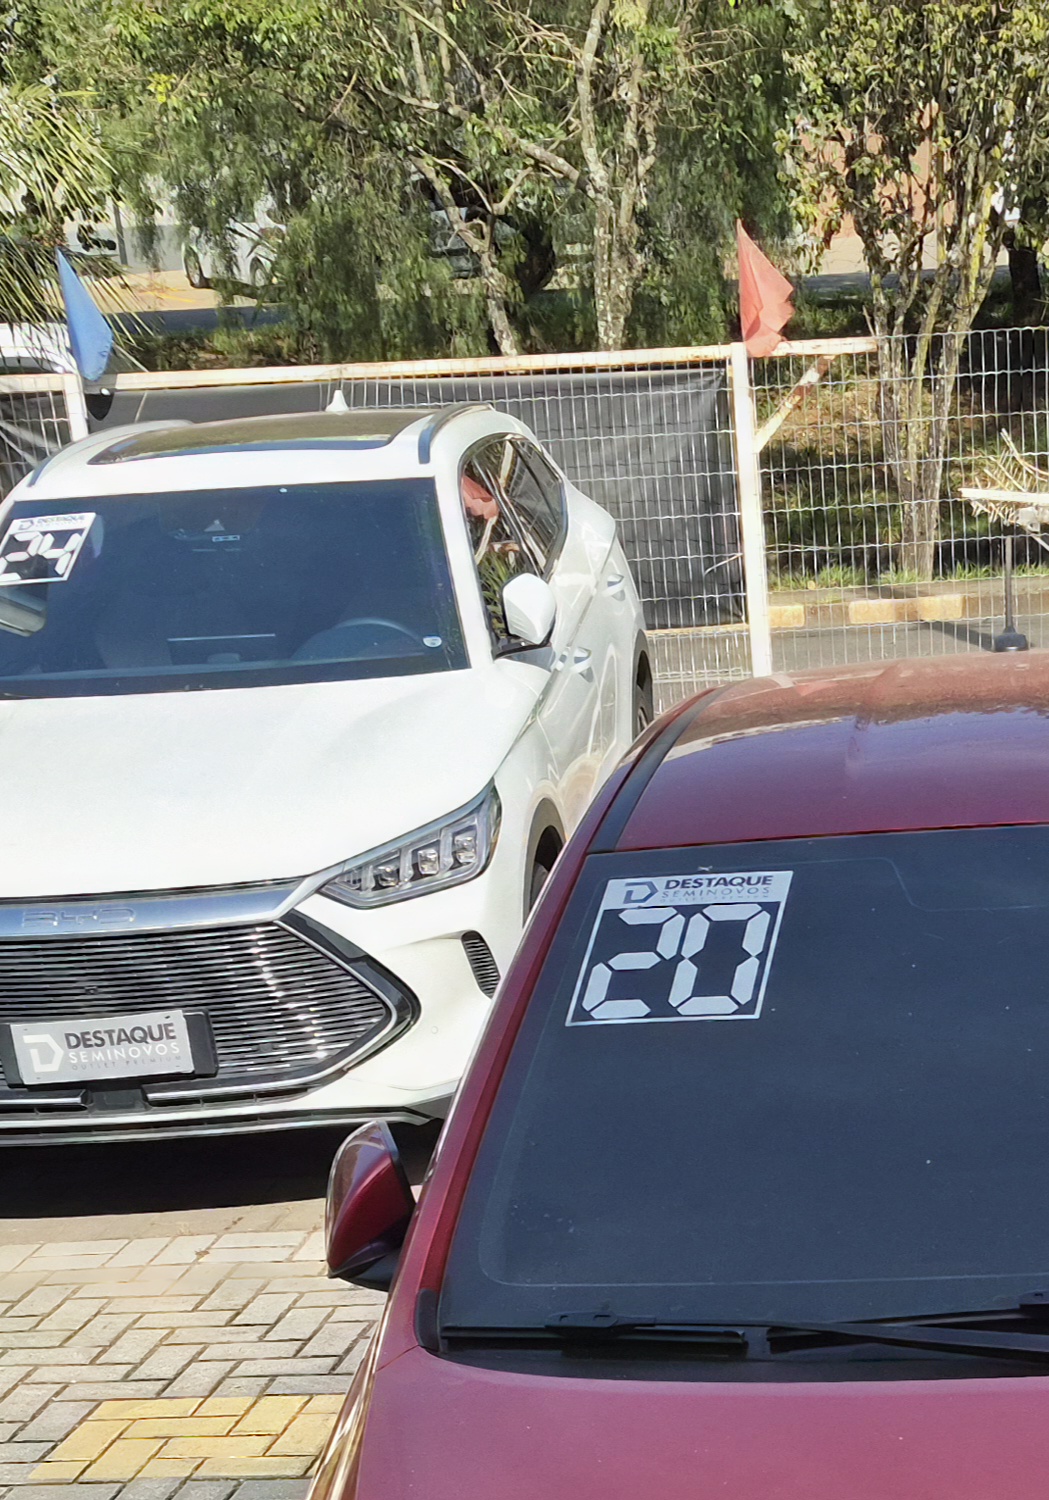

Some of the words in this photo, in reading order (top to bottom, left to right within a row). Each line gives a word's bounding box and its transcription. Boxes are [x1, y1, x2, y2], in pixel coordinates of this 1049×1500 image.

[0, 531, 82, 581] 24
[661, 887, 771, 899] SEMINOVOS
[664, 875, 774, 890] DESTAQUE
[581, 903, 771, 1020] 20
[64, 1023, 177, 1050] DESTAQUE
[68, 1042, 180, 1064] SEMINOVOS
